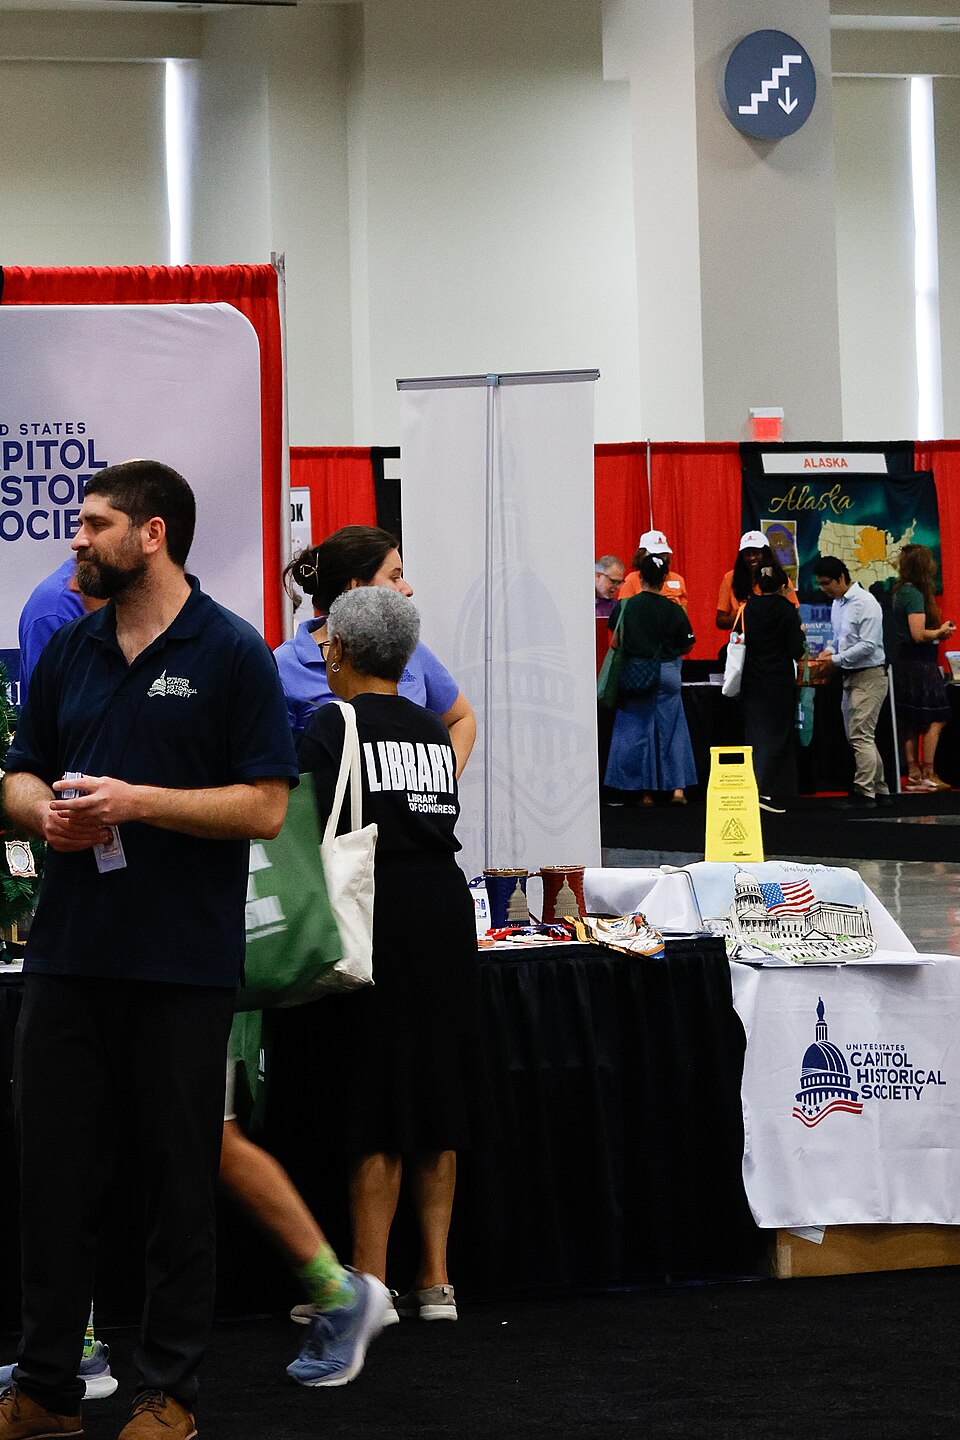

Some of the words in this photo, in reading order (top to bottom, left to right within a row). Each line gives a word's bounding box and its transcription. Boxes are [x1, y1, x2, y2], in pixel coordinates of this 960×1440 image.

[19, 422, 86, 435] STATES
[803, 458, 848, 468] ALASKA
[767, 483, 855, 515] Alaska
[362, 741, 454, 794] LIBRARY
[407, 793, 438, 803] LIBRARY
[408, 803, 418, 812] OF
[419, 803, 457, 815] CONGRESS
[879, 1043, 905, 1051] STATES
[850, 1052, 913, 1067] CAPITOL
[856, 1068, 946, 1085] HISTORICAL
[860, 1084, 923, 1100] SOCIETY
